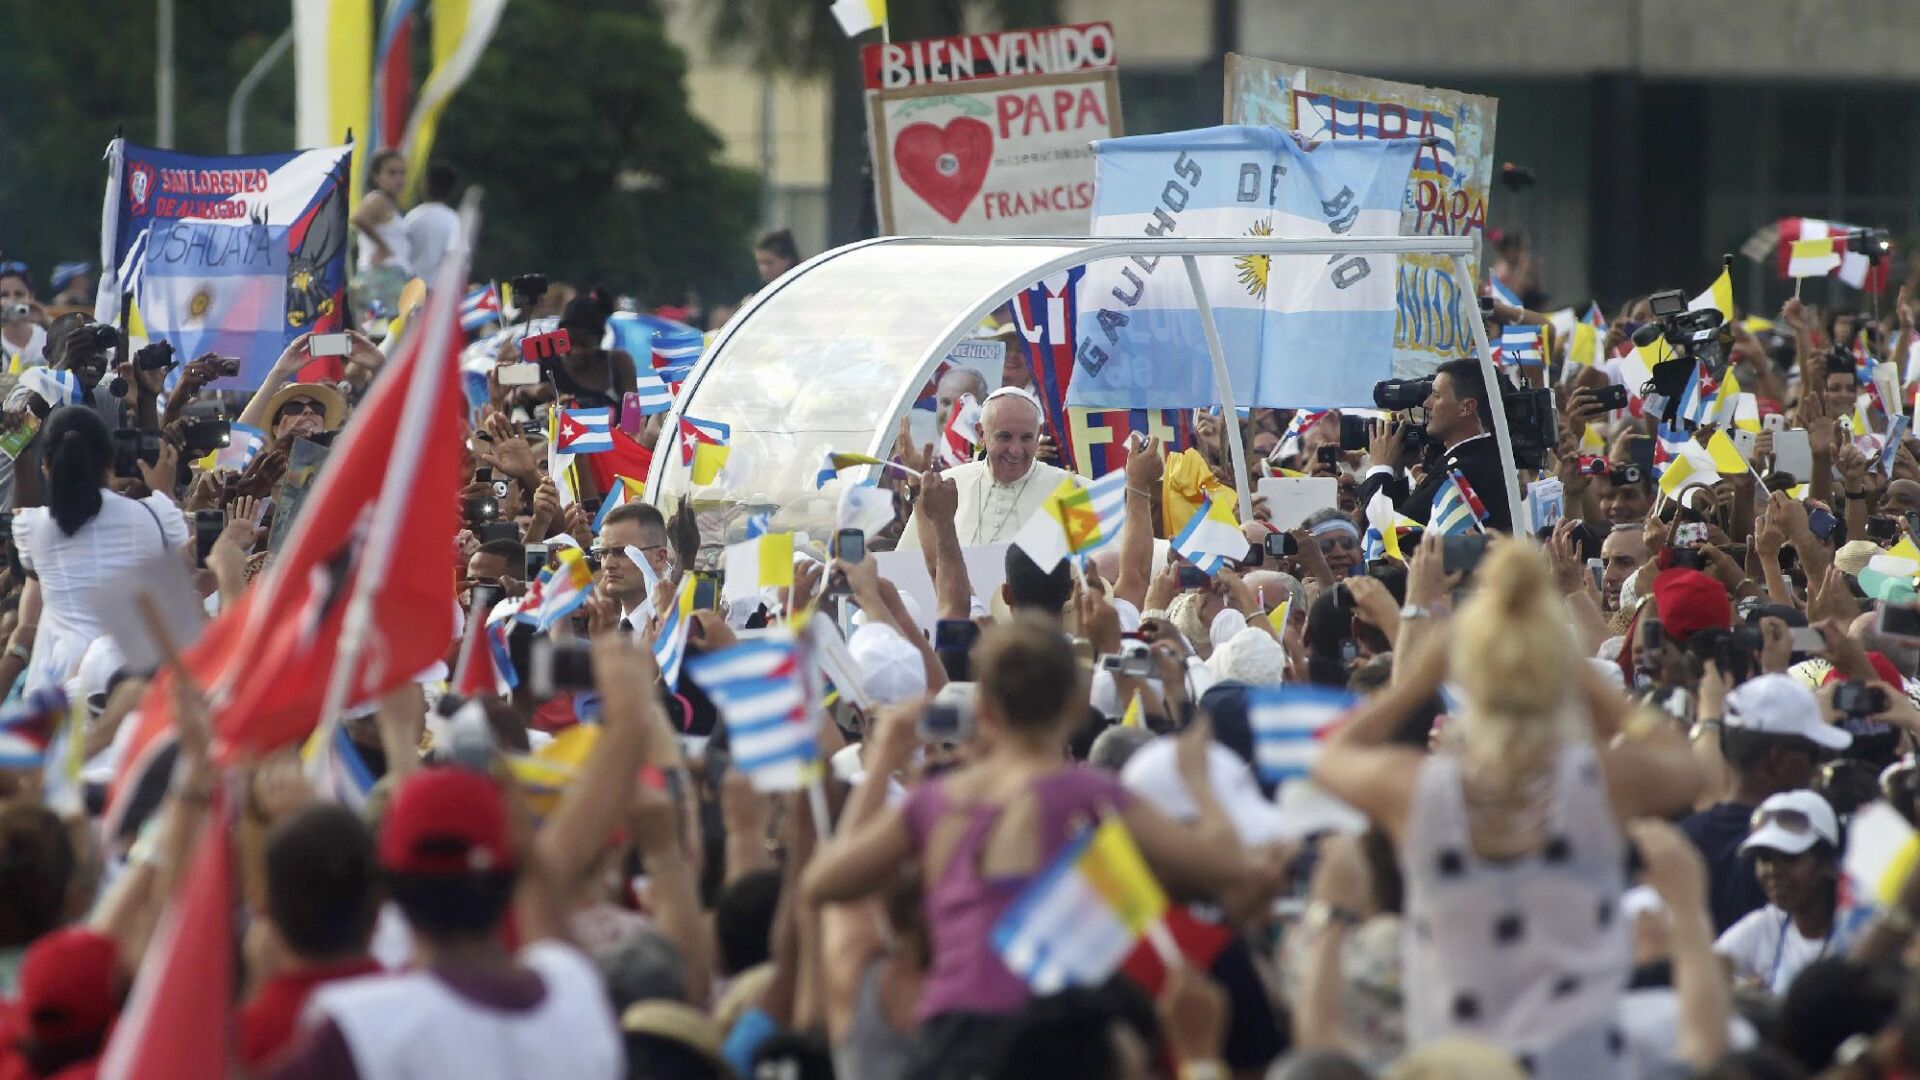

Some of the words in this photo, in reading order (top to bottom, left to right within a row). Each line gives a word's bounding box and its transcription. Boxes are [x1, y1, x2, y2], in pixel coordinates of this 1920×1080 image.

[996, 87, 1107, 139] PAPA
[160, 167, 188, 193] SAN
[188, 167, 269, 195] LORENZO
[156, 197, 177, 217] DE
[983, 182, 1095, 221] FRANCIS
[1414, 179, 1486, 241] PAPA
